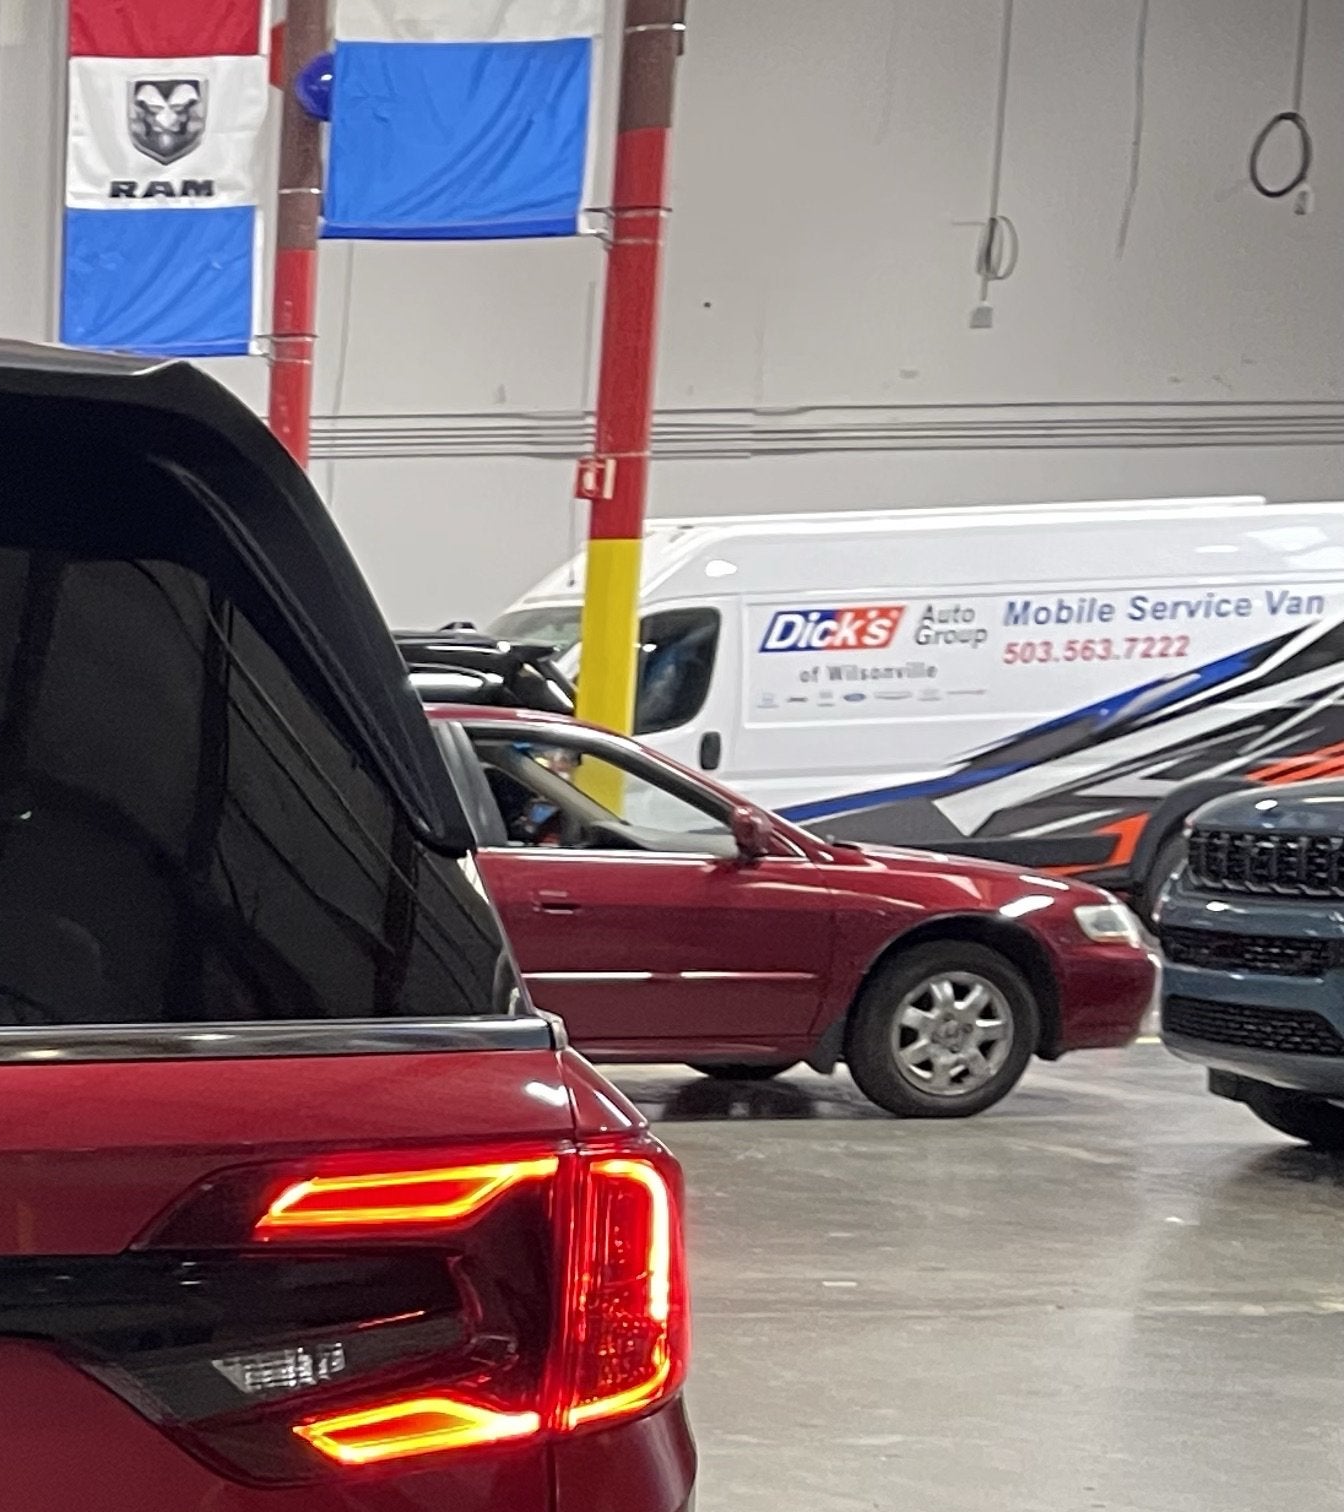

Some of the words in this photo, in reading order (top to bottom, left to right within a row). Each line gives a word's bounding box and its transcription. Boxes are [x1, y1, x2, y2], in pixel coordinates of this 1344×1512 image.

[109, 179, 215, 199] RAM
[920, 604, 976, 624] Auto
[1002, 597, 1116, 627] Mobile
[1127, 592, 1253, 622] Service
[1264, 589, 1326, 616] Van
[763, 609, 896, 649] Dick's
[914, 624, 989, 649] Group
[1002, 634, 1191, 665] 503.563.7222
